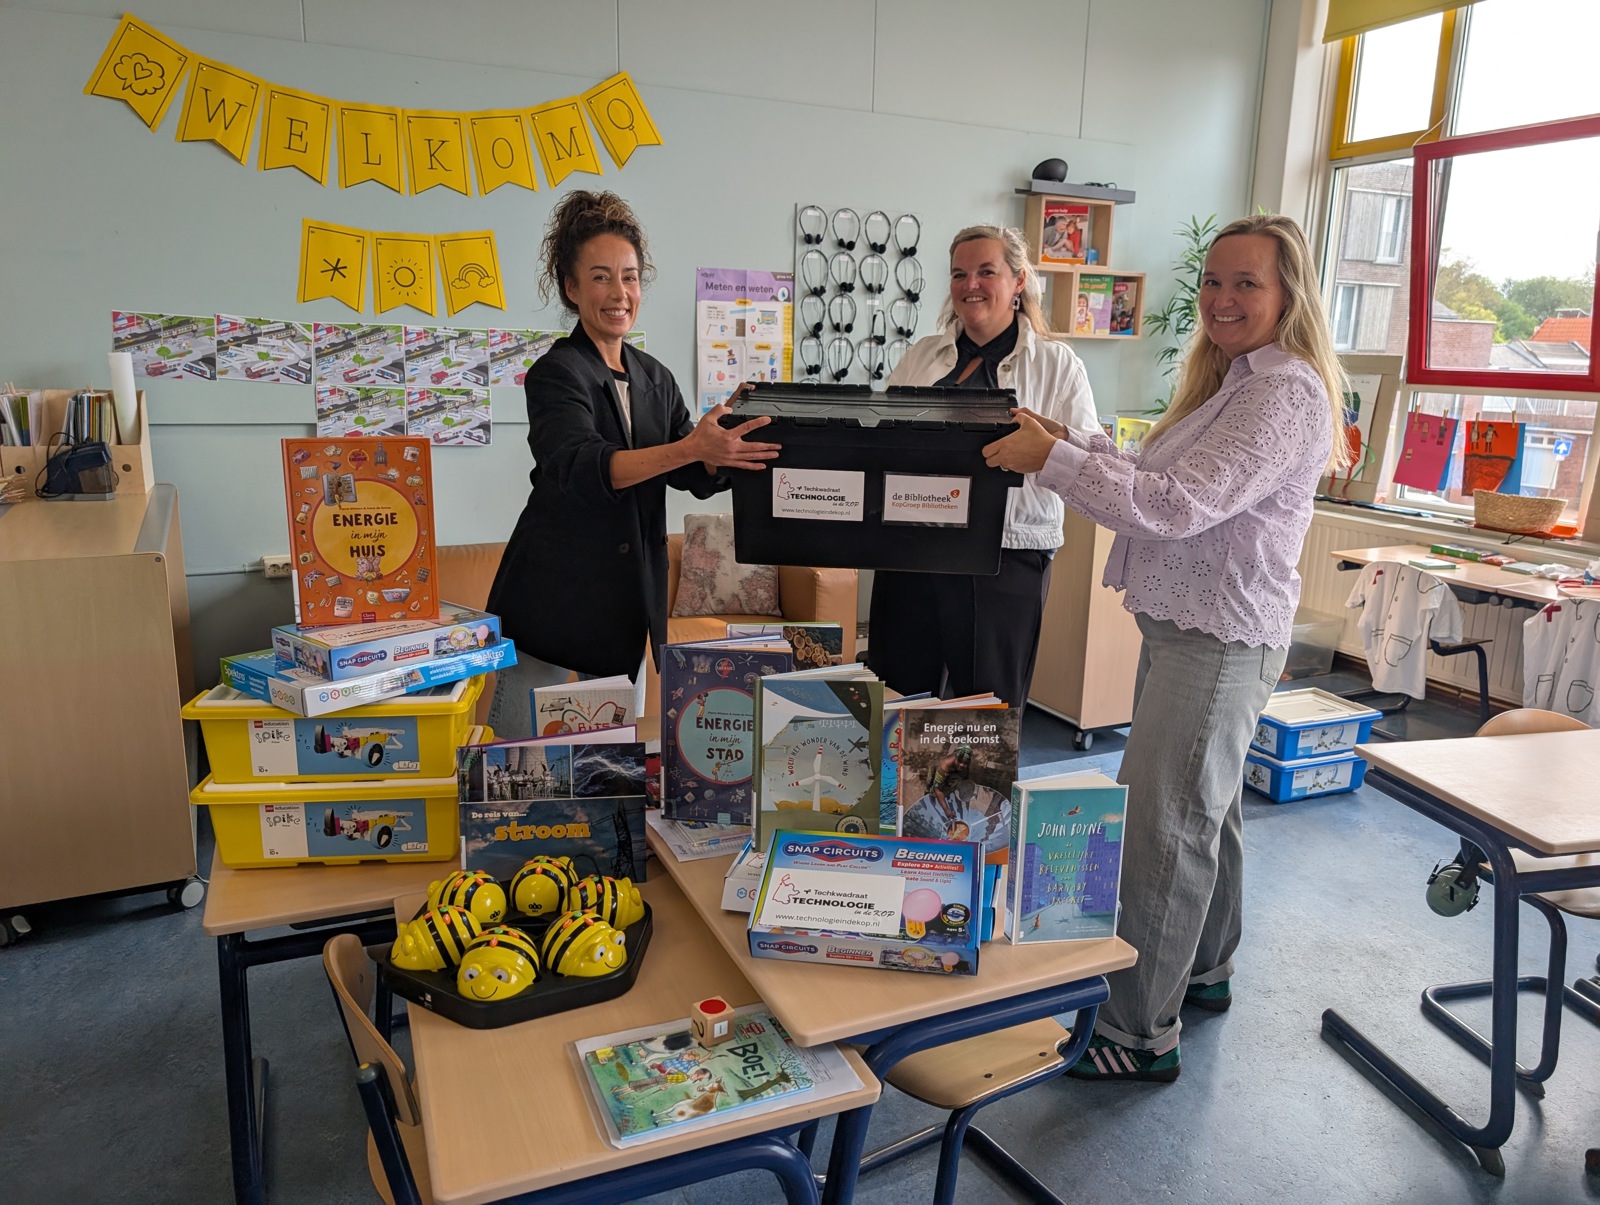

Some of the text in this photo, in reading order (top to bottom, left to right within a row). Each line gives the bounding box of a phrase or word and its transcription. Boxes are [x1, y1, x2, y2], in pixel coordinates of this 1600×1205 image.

[200, 86, 586, 172] WELKOM
[705, 282, 733, 291] Meten
[748, 285, 774, 293] weten
[790, 493, 846, 501] TECHNOLOGIE
[892, 492, 951, 502] de Bibliotheek
[891, 501, 921, 509] KopGroep
[781, 508, 851, 516] www.technologieindekop.nl
[332, 512, 398, 527] ENERGIE
[351, 529, 387, 543] in mijn
[350, 545, 386, 558] HUIS
[339, 652, 385, 667] SNAP CIRCUITS
[224, 665, 246, 681] Spektro
[696, 717, 754, 732] ENERGIE
[924, 722, 997, 735] Energie nu en
[709, 733, 742, 747] in mijn
[800, 736, 828, 747] WONDER
[829, 740, 840, 751] VAN
[920, 734, 1000, 744] in de toekomst
[706, 748, 744, 760] STAD
[791, 745, 802, 757] HET
[839, 750, 848, 759] DE
[841, 759, 849, 777] WIND
[494, 821, 591, 841] stroom
[1037, 821, 1104, 838] JOHN BOYNE
[787, 844, 878, 858] SNAP CIRCUITS
[894, 848, 963, 863] BEGINNER
[1048, 850, 1095, 862] VRESELIJKE
[897, 861, 921, 869] Explore
[1038, 863, 1100, 876] BELEVENISSEN
[813, 889, 868, 899] Techkwadraat
[1047, 882, 1087, 893] BARNABY
[792, 897, 875, 910] TECHNOLOGIE
[775, 913, 880, 928] www.technologieindekop.nl
[873, 910, 896, 918] KOP
[781, 944, 815, 952] CIRCUITS
[726, 1042, 771, 1080] BOE!
